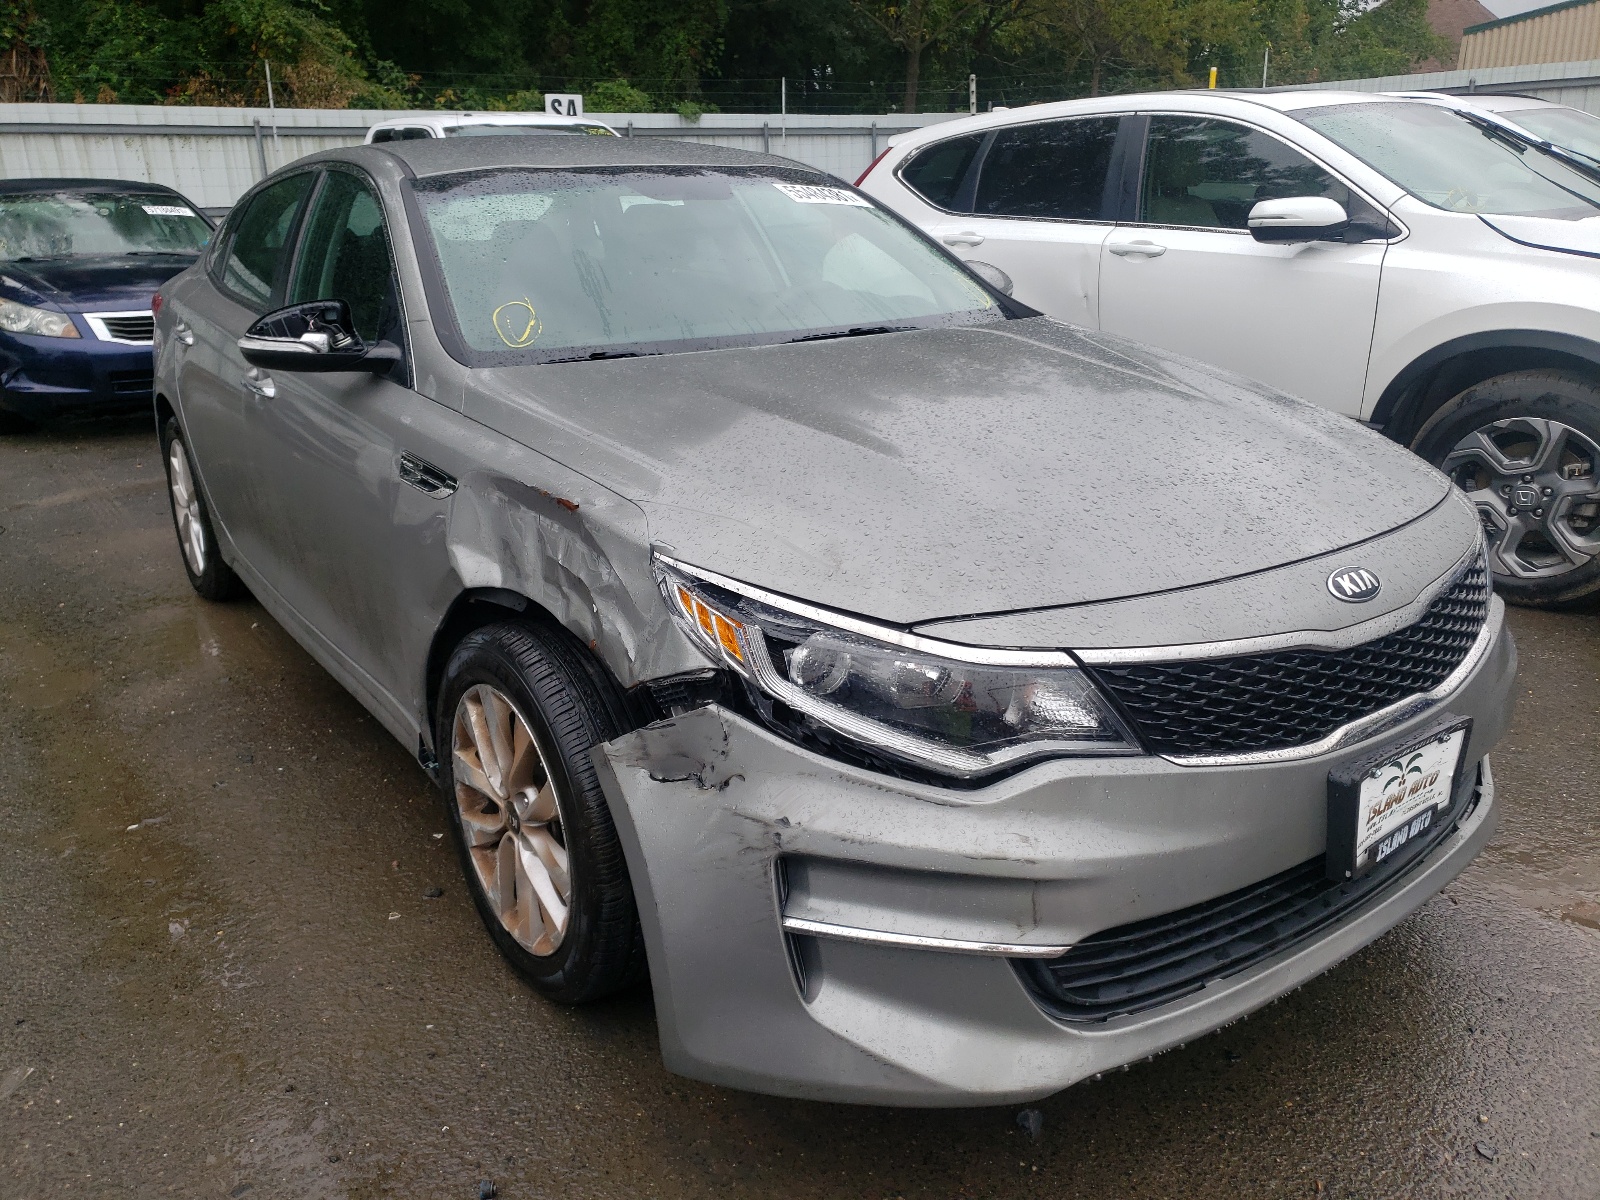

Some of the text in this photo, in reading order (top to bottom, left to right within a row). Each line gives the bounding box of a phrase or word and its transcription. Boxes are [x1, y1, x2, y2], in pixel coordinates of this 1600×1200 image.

[1334, 569, 1379, 596] KIA
[1366, 786, 1408, 827] ISLAND
[1408, 769, 1441, 797] AUTO
[1376, 825, 1409, 863] ISLAND
[1408, 809, 1433, 839] AUTO
